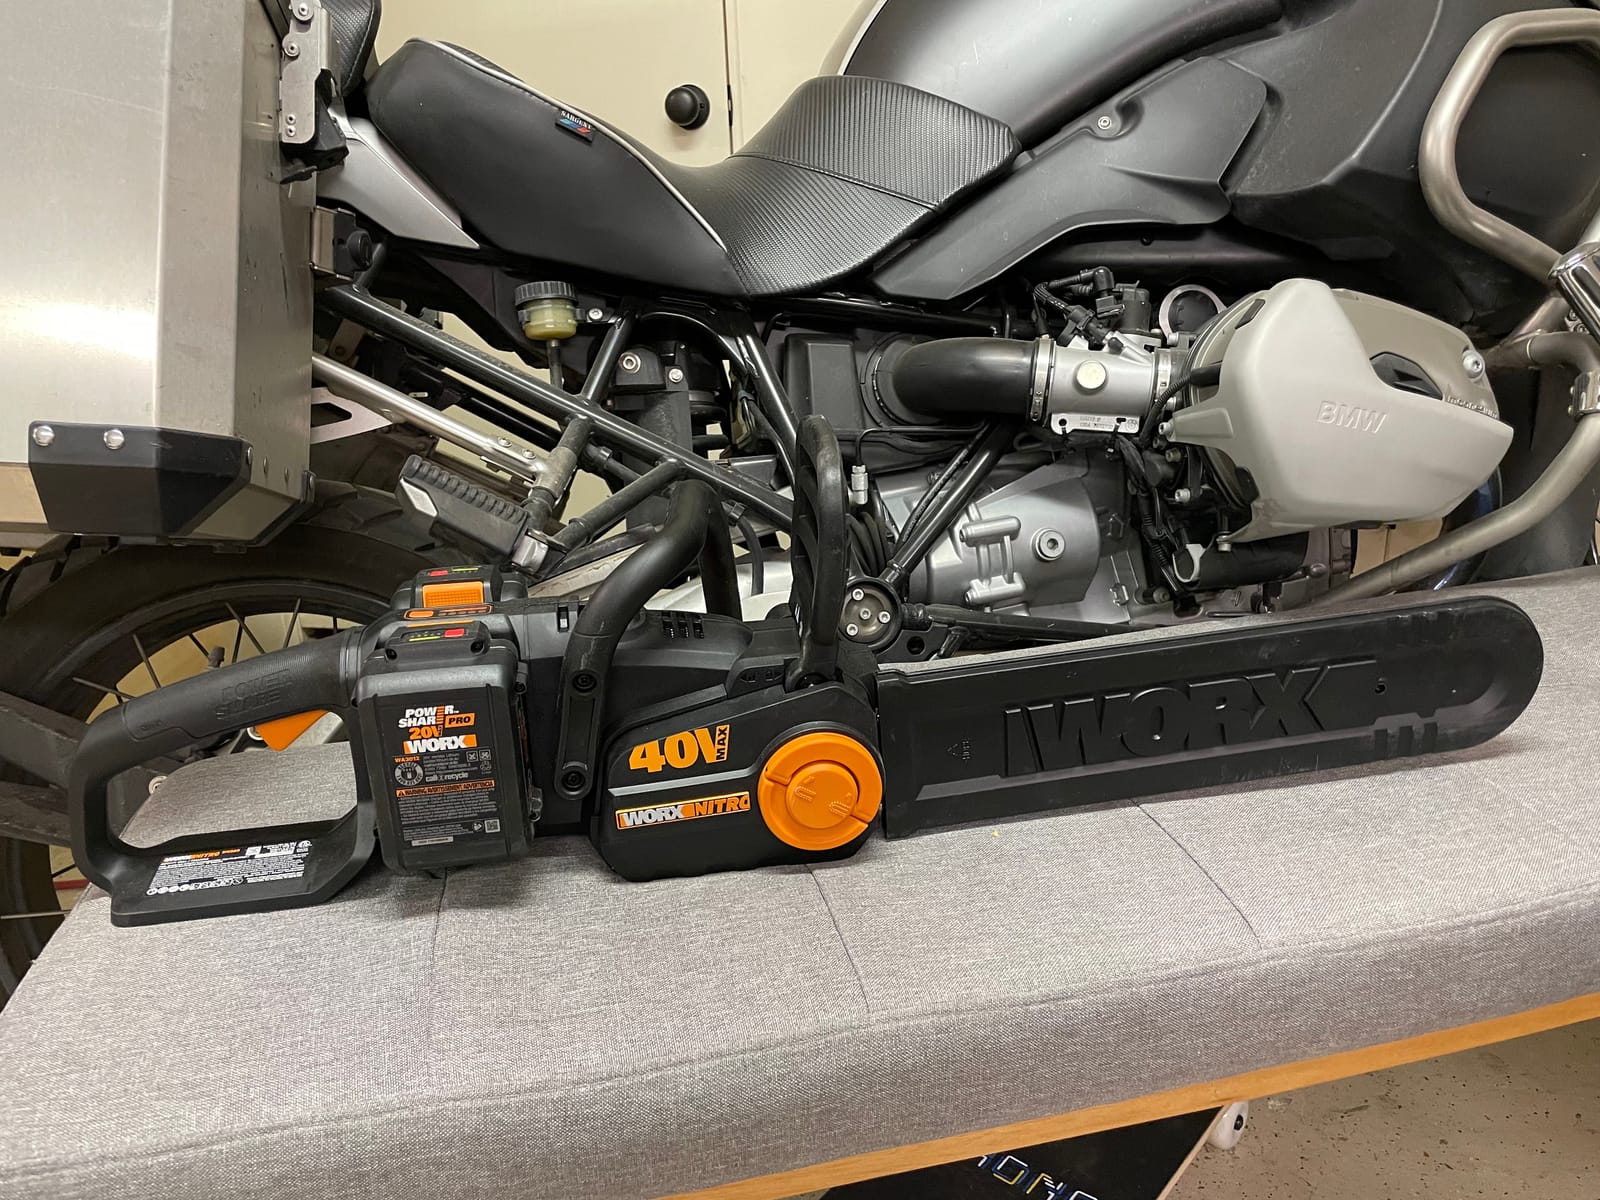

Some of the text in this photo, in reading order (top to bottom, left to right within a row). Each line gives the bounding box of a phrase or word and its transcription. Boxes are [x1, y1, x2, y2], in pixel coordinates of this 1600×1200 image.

[560, 110, 593, 130] SARGENT
[1316, 400, 1387, 434] BMW
[398, 715, 471, 728] SHARE PRO
[405, 705, 455, 718] POWER
[1027, 666, 1326, 772] WORX
[406, 735, 464, 754] WORX
[628, 726, 717, 773] 40V
[717, 726, 729, 761] MAX
[622, 795, 751, 827] WORX NITRO
